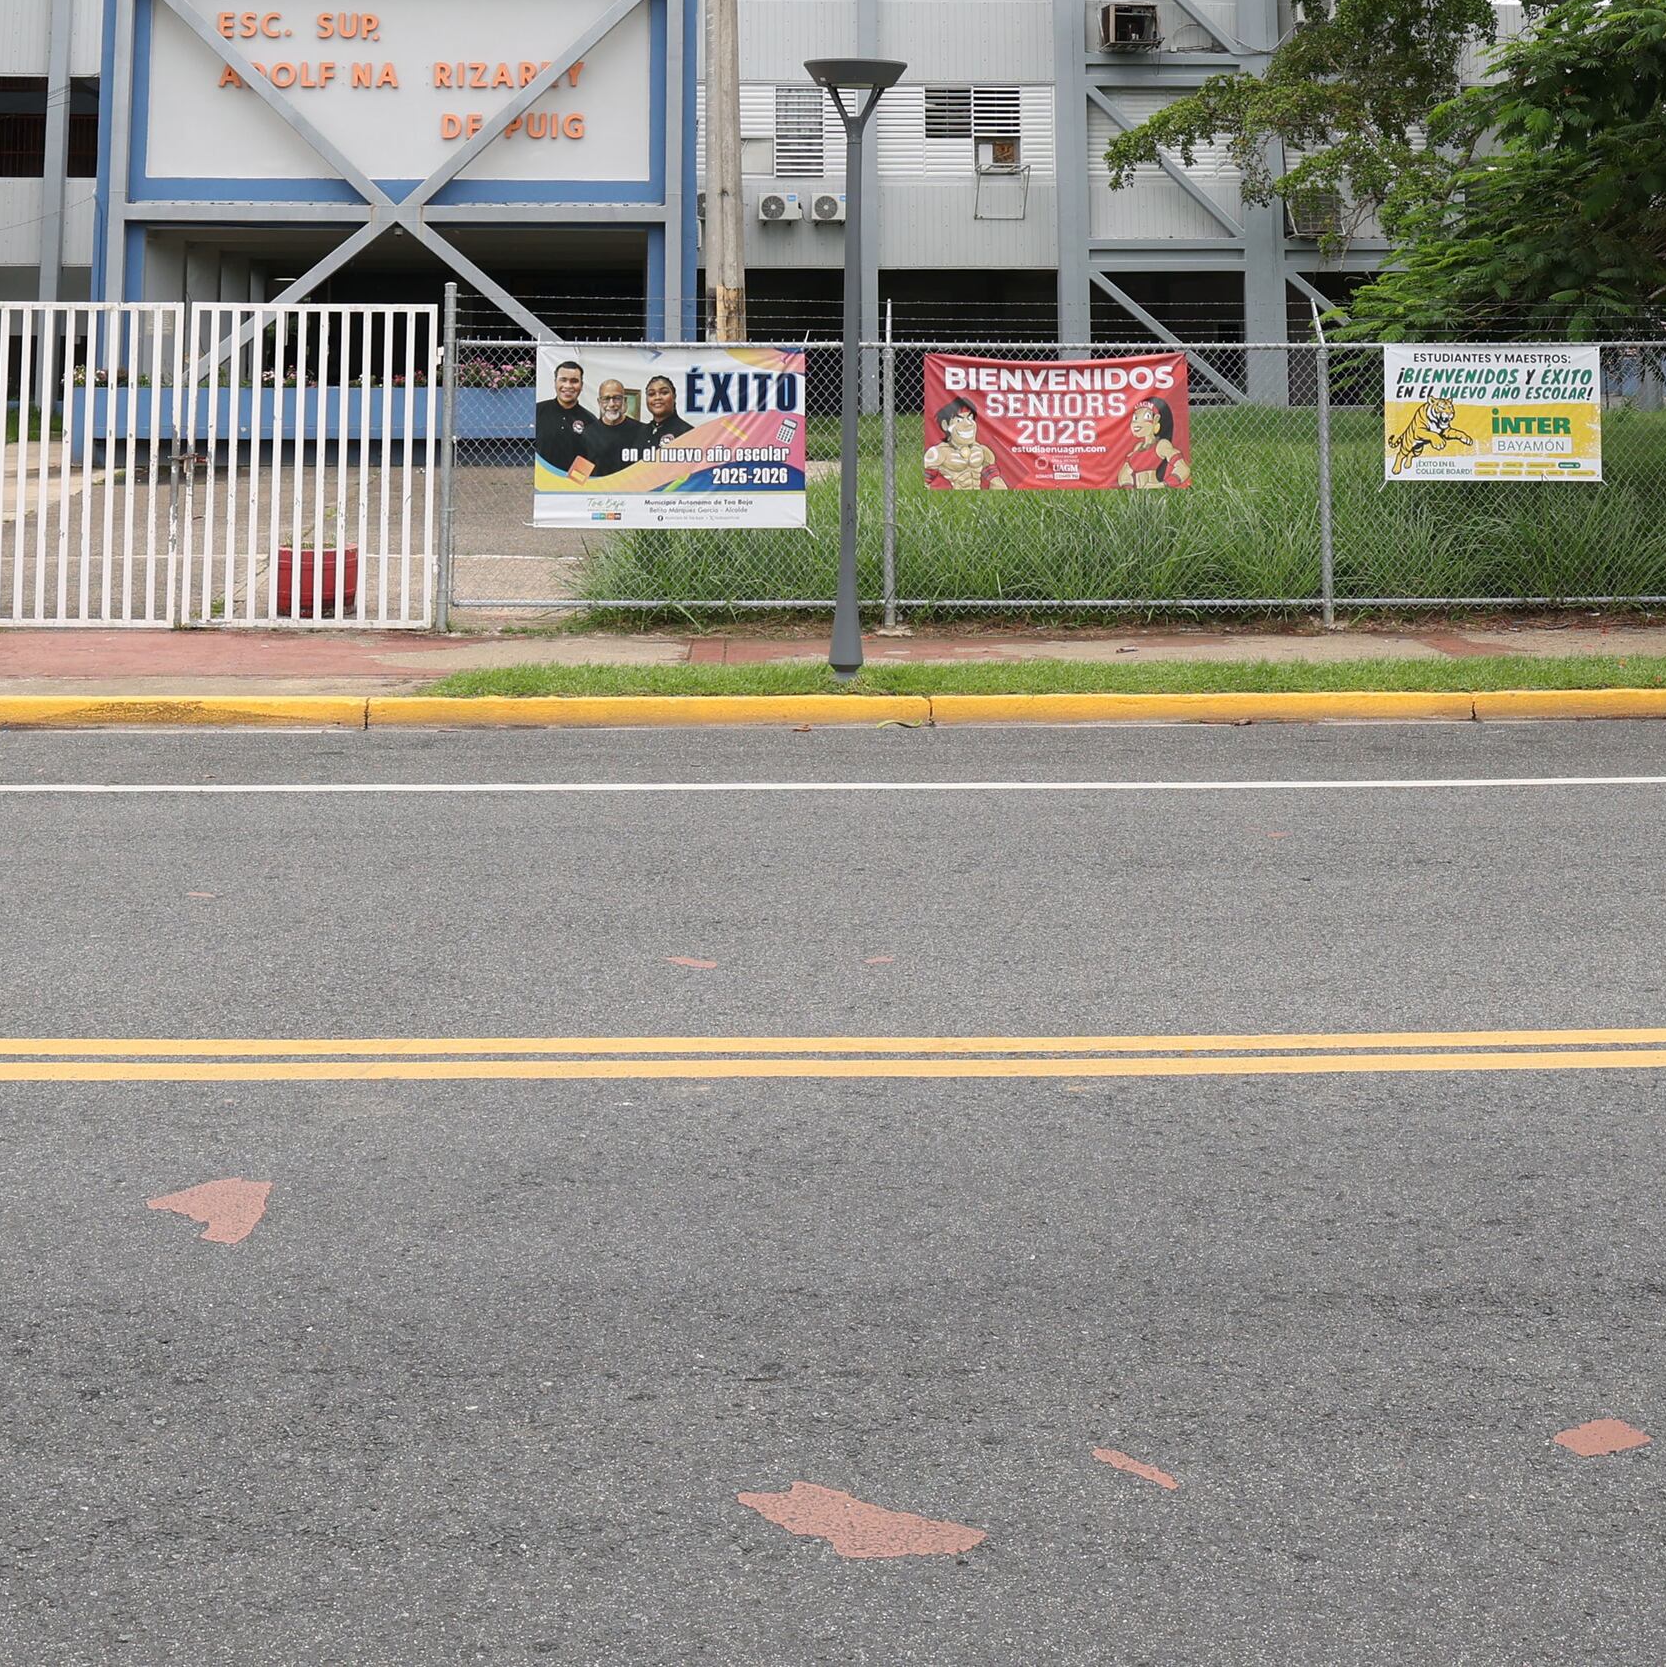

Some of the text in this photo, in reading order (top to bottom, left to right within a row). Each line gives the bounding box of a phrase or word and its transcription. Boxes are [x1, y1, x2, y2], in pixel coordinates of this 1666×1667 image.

[217, 12, 380, 41] ESC. SUP.
[433, 62, 585, 88] RIZARY
[1414, 353, 1571, 364] ESTUDIANTES Y MAESTROS:
[944, 366, 1174, 391] BIENVENIDOS
[1397, 364, 1593, 385] ¡BIENVENIDOS Y ÉXITO
[686, 366, 797, 413] ÉXITO
[1396, 386, 1417, 398] EN
[1440, 386, 1486, 399] NUEVO
[1492, 384, 1520, 399] AÑO
[1526, 387, 1593, 400] ESCOLAR!
[986, 393, 1126, 417] SENIORS
[1017, 420, 1096, 444] 2026
[622, 446, 789, 462] en el nuevo año escolar
[1011, 445, 1107, 454] estudiaenuagm.com
[1498, 438, 1564, 452] BAYAMÓN
[712, 468, 788, 484] 2025-2026
[1052, 464, 1079, 472] UAGM
